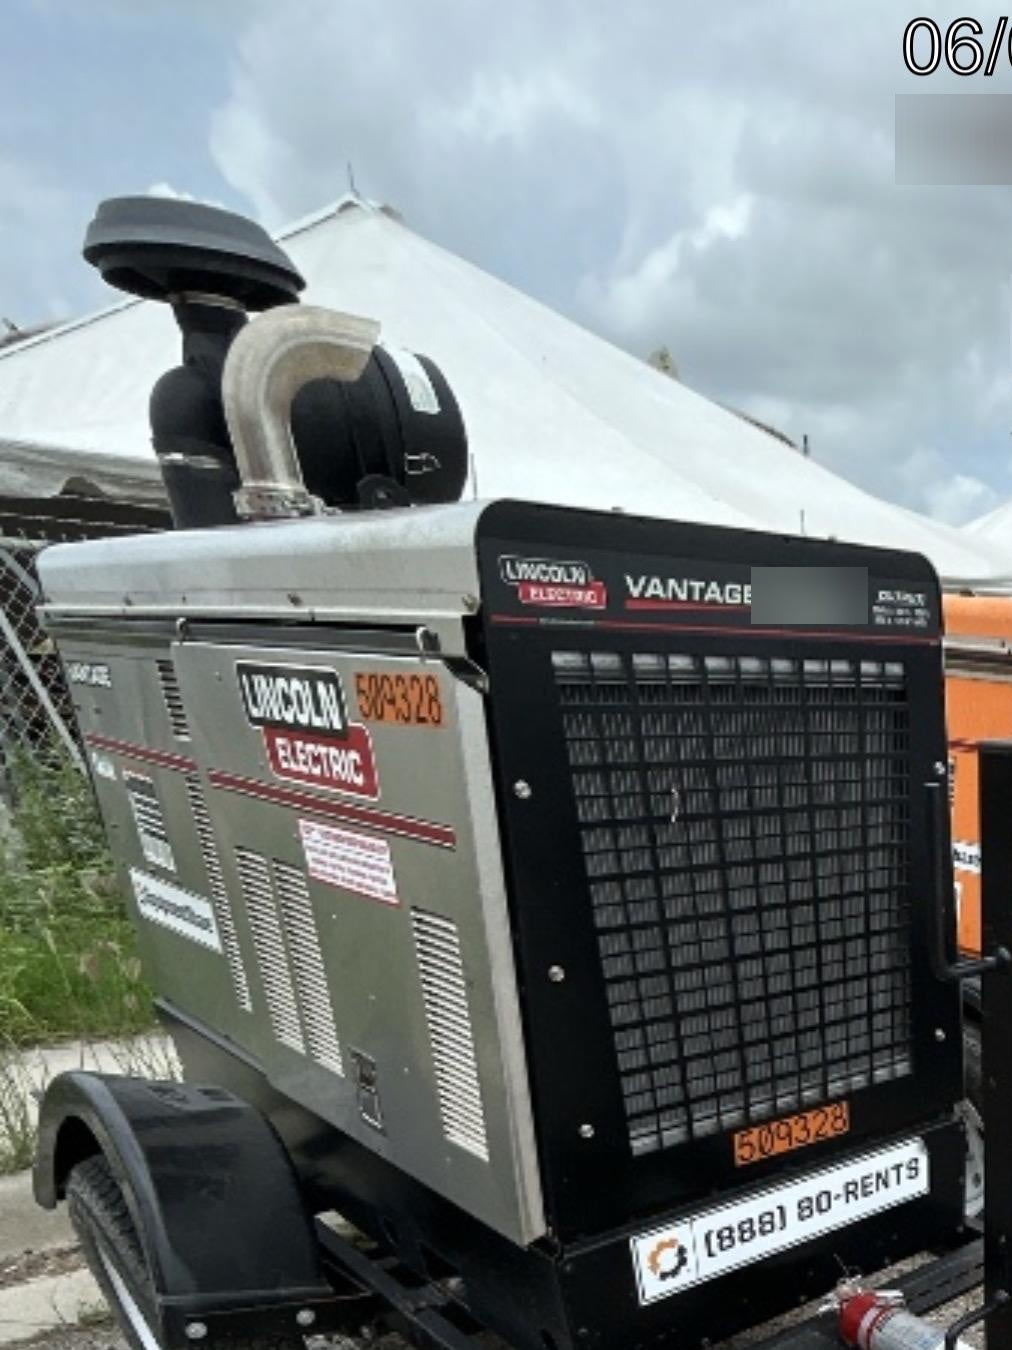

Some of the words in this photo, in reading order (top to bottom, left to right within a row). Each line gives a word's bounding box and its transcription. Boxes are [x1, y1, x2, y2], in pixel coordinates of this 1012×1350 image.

[505, 560, 586, 584] LINCOLN
[242, 673, 343, 730] LINCOLN
[355, 673, 442, 725] 509328
[274, 736, 365, 786] ELECTRIC
[736, 1101, 848, 1163] 509328
[796, 1157, 920, 1222] 80-RENTS
